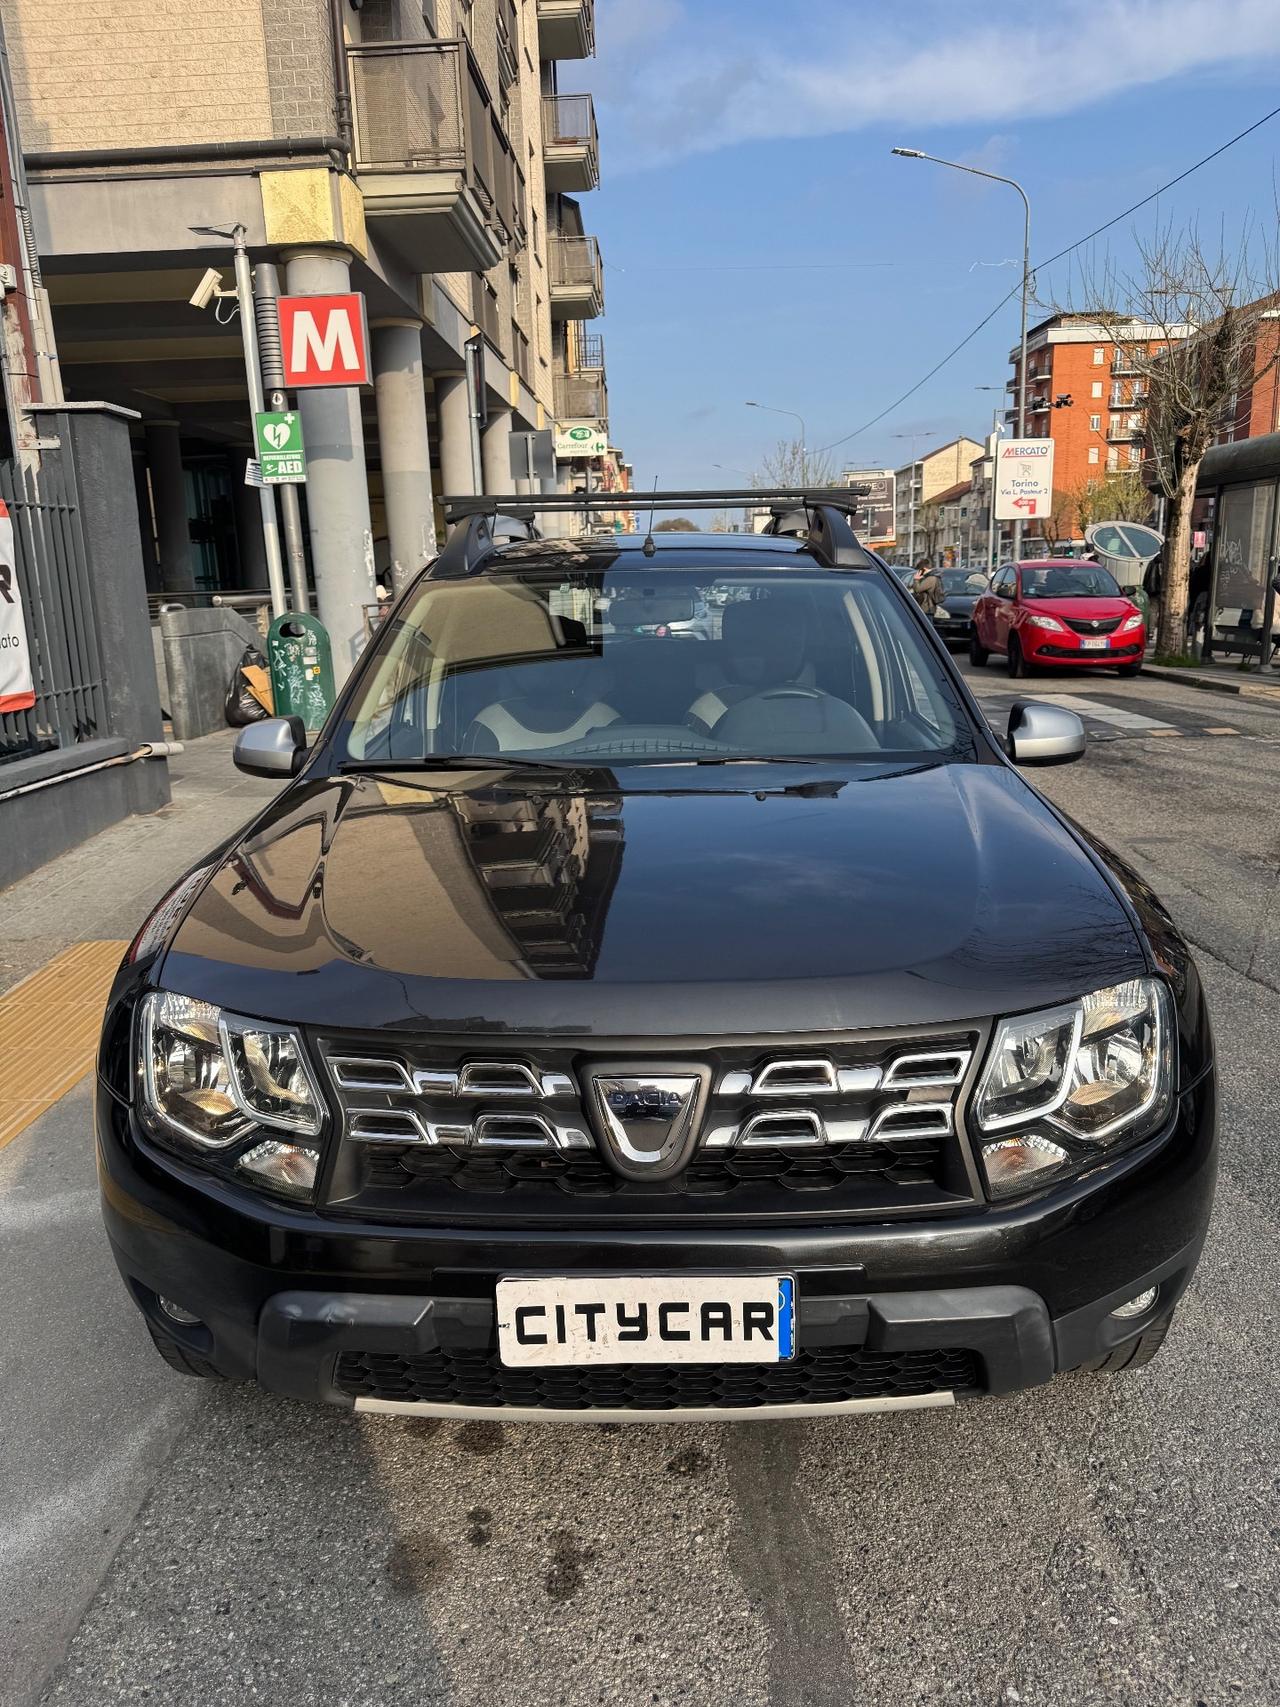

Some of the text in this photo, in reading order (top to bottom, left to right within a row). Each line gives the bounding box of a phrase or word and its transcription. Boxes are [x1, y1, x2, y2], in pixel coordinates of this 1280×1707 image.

[291, 309, 360, 373] M
[1002, 446, 1048, 458] MERCATO
[278, 461, 302, 473] AED
[1011, 479, 1039, 487] Torino
[0, 633, 19, 649] ato
[610, 1092, 682, 1105] DACIA
[515, 1302, 775, 1345] CITYCAR
